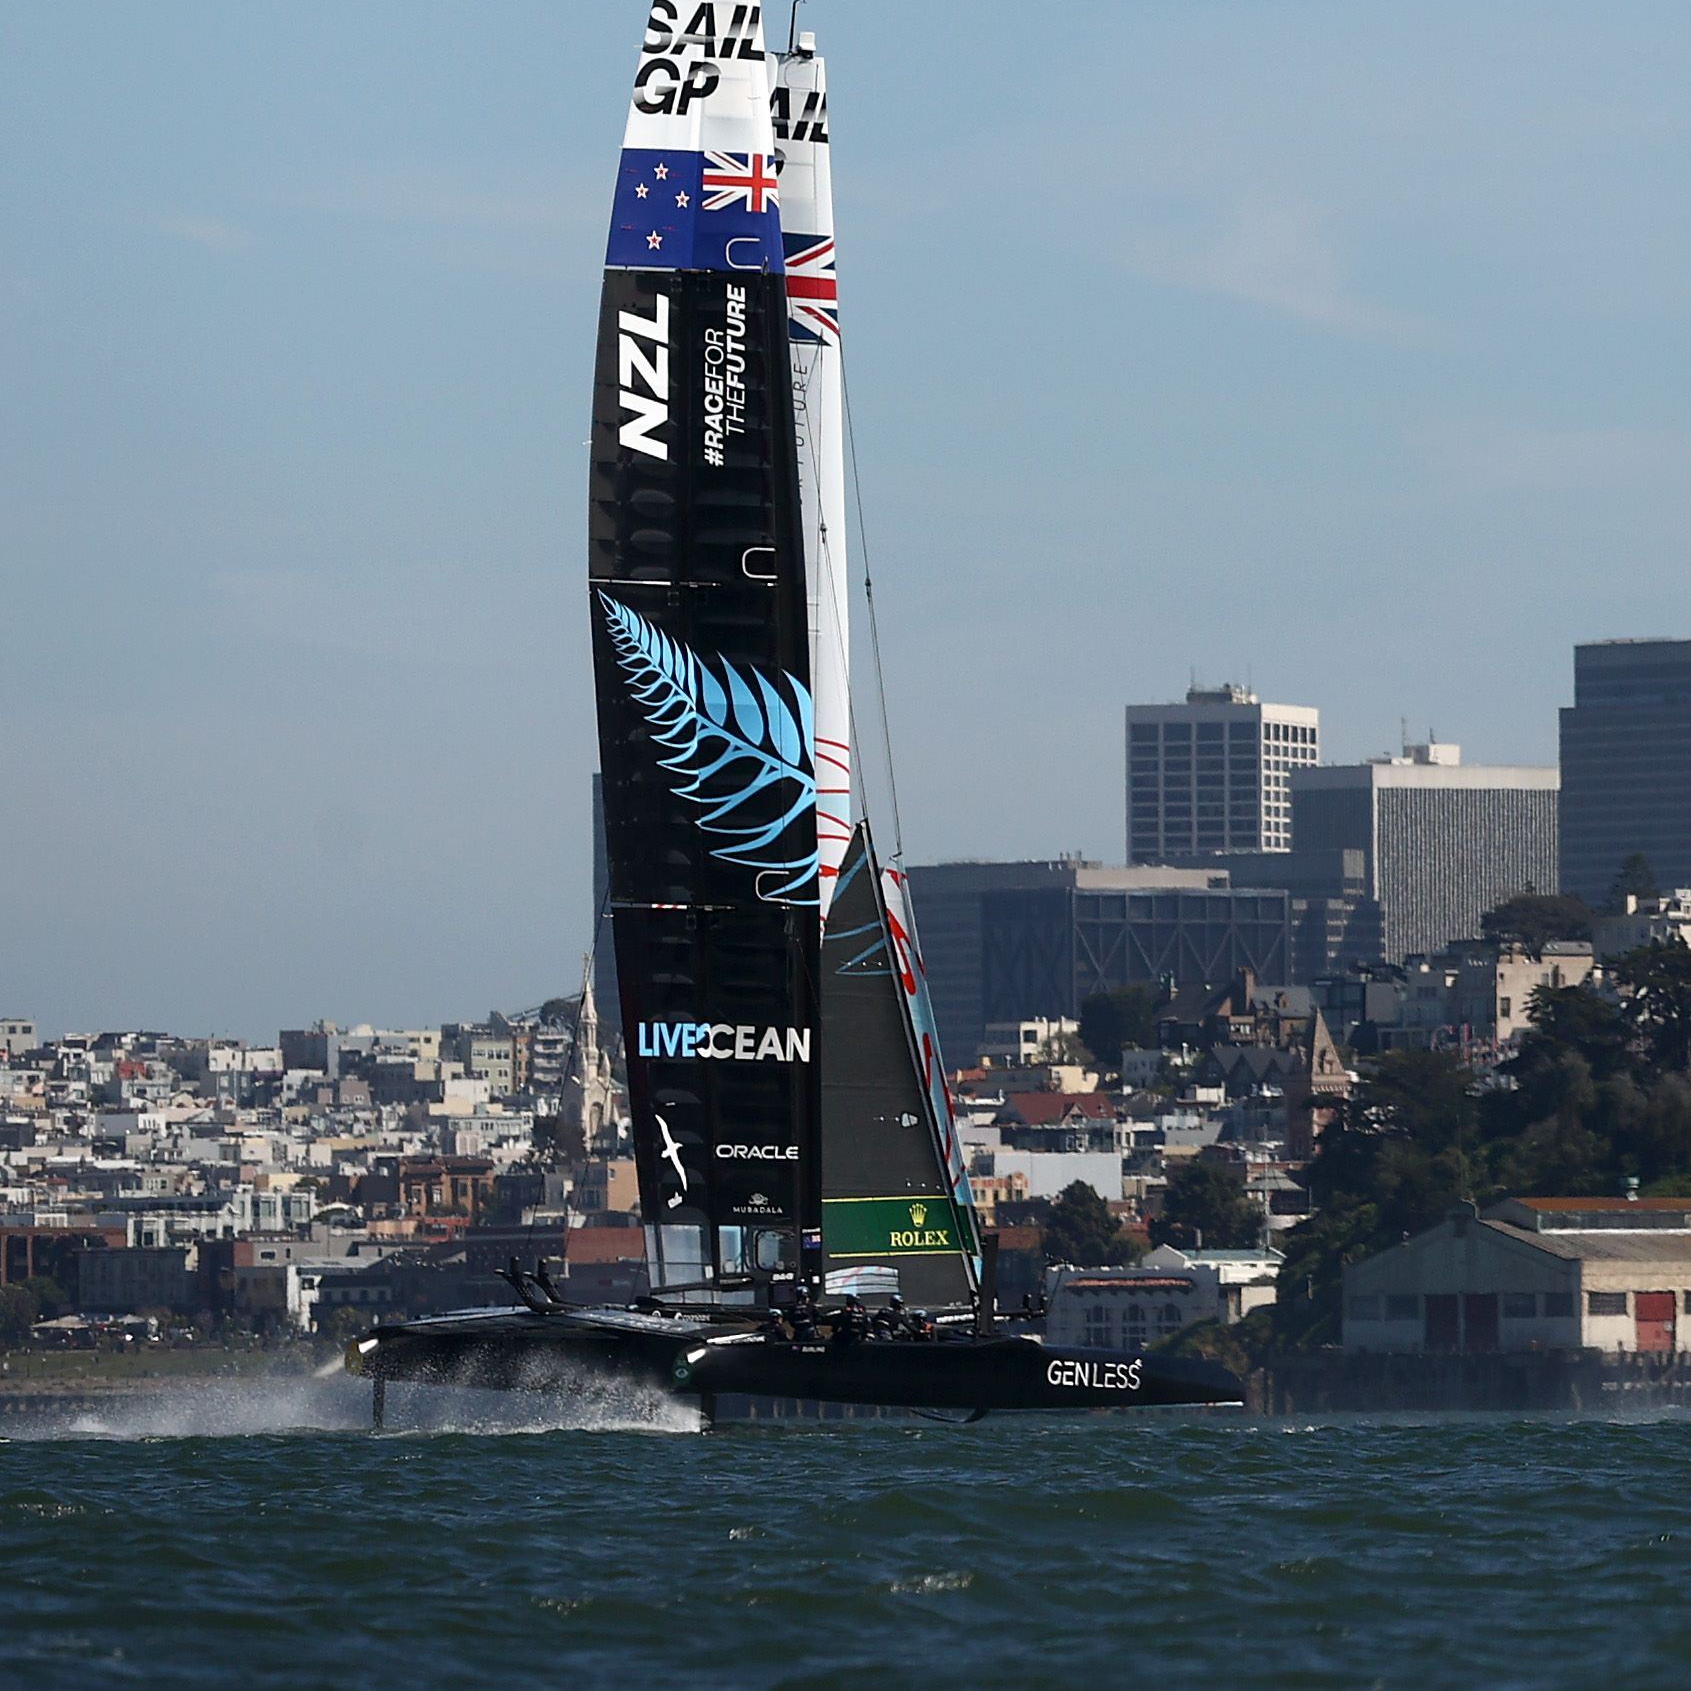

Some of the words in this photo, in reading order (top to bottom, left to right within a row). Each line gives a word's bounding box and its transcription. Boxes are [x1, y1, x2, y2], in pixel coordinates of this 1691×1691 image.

[632, 58, 719, 116] GP
[770, 87, 829, 143] AIL
[619, 293, 669, 460] NZL
[715, 1144, 799, 1160] ORACLE
[890, 1230, 949, 1247] ROLEX
